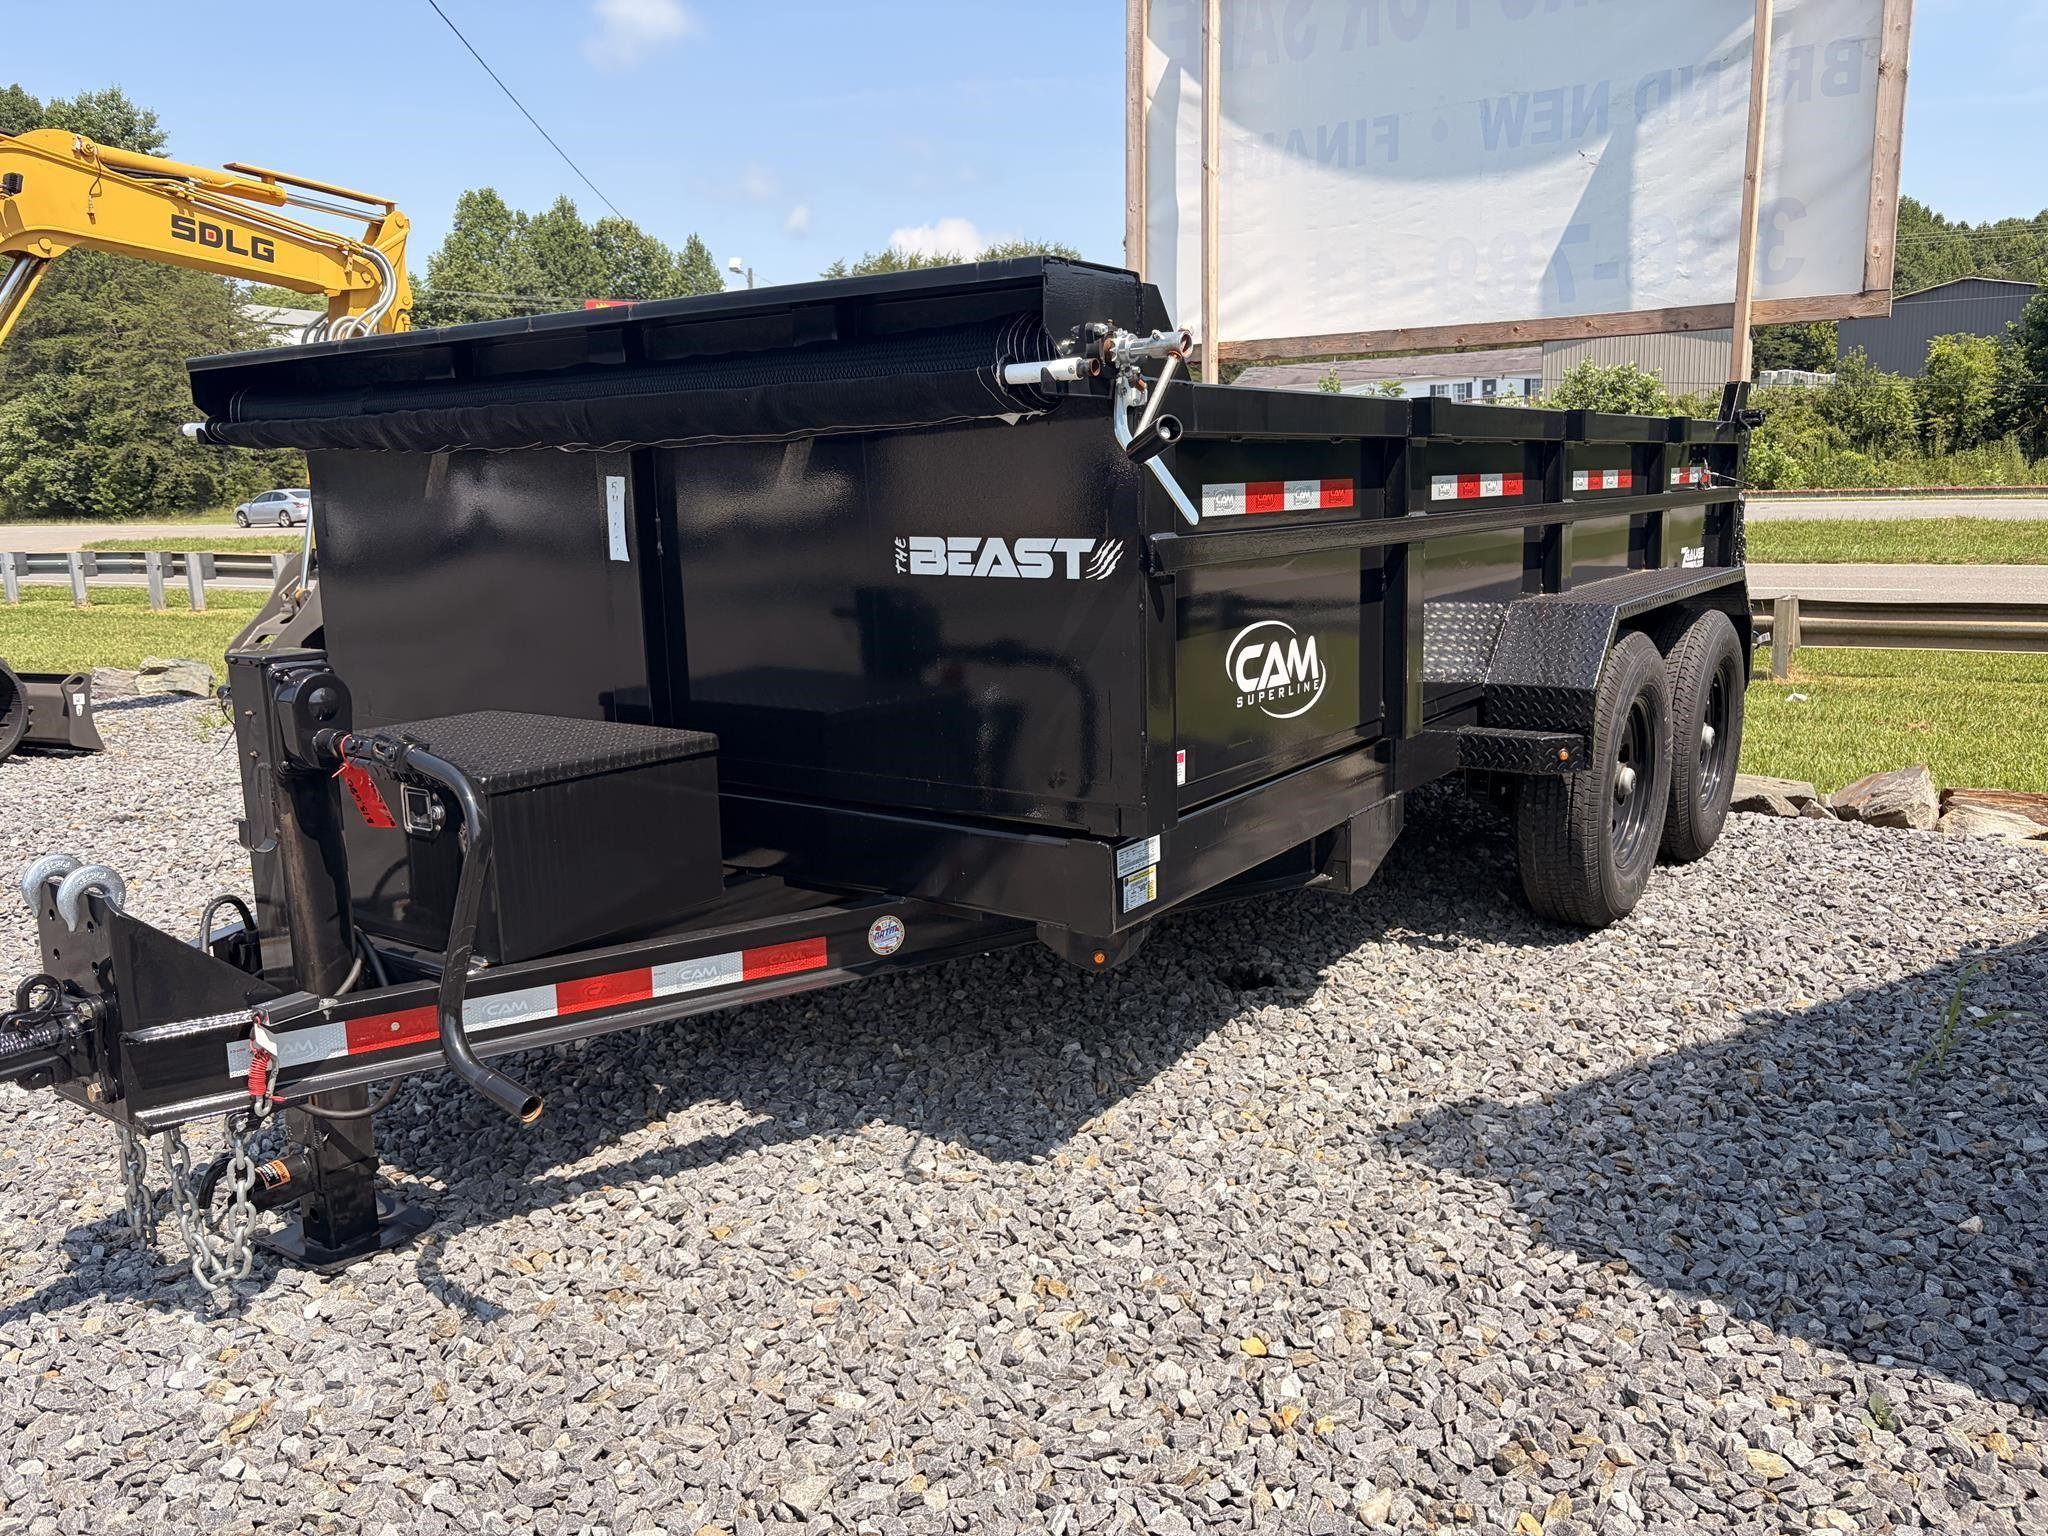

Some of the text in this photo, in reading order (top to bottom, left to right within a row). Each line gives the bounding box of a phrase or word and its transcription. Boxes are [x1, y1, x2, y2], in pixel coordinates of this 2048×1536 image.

[172, 214, 274, 263] SDLG
[895, 536, 1096, 580] THE BEAST
[1236, 635, 1319, 693] CAM
[1236, 679, 1320, 708] SUPERLINE
[680, 966, 718, 981] CAM
[487, 1000, 529, 1018] CAM
